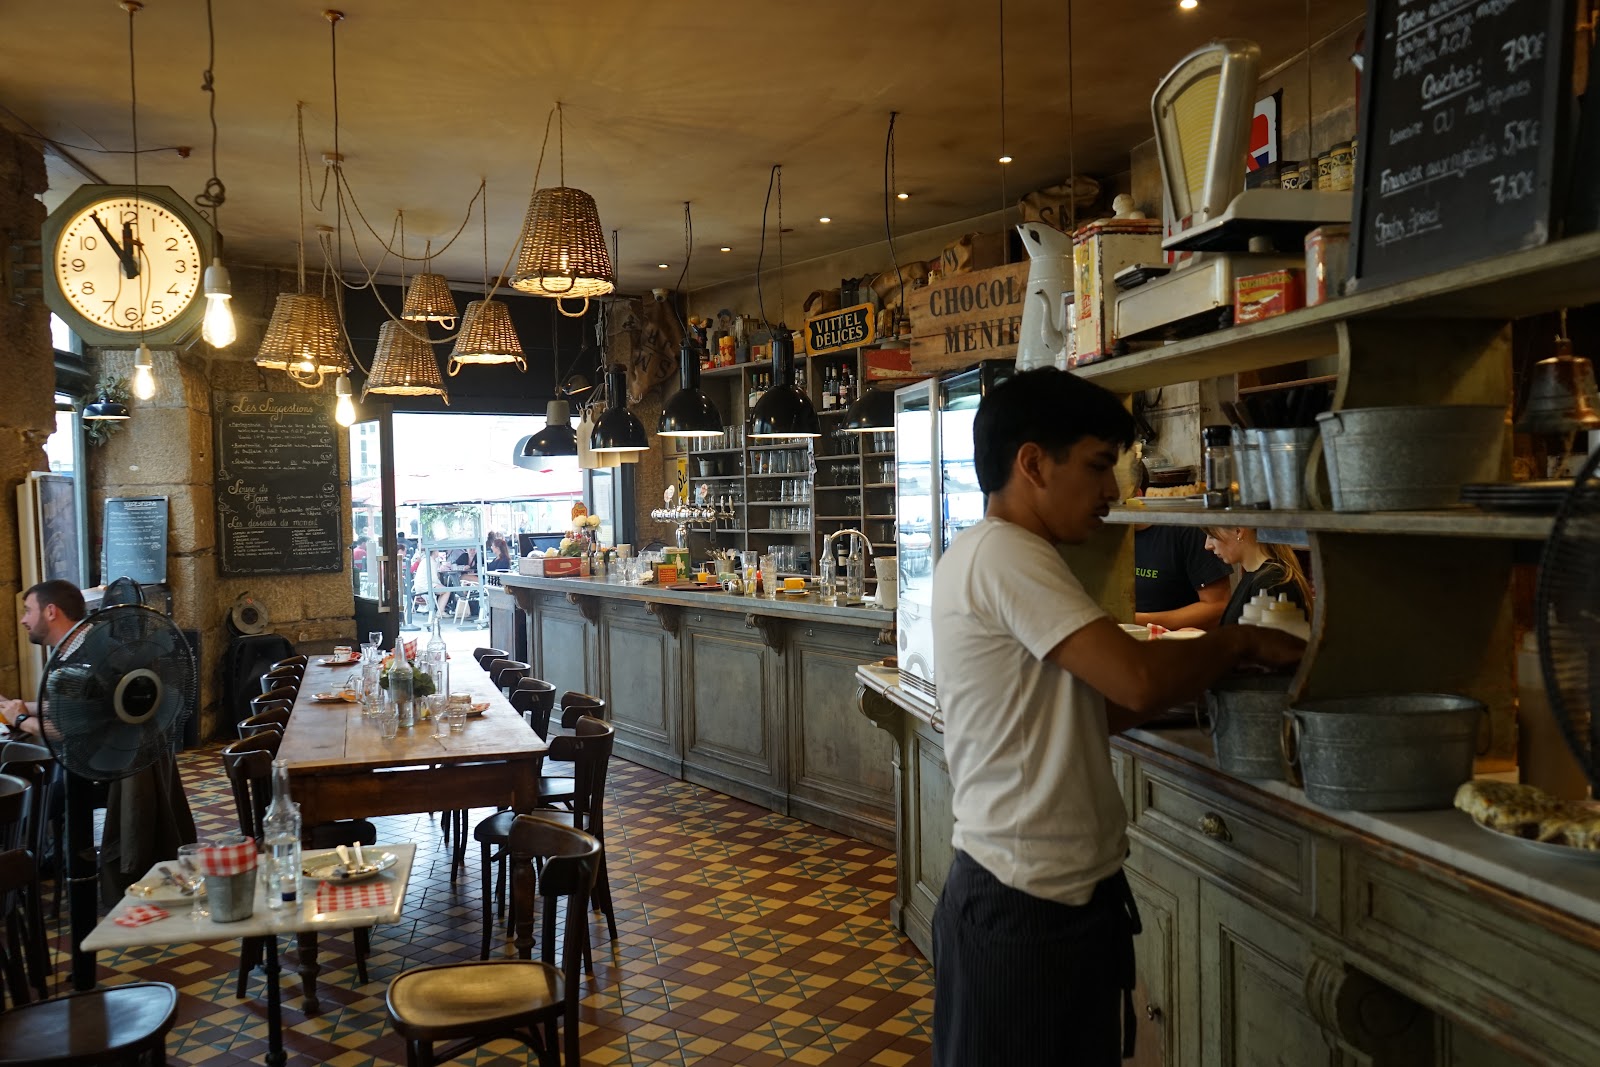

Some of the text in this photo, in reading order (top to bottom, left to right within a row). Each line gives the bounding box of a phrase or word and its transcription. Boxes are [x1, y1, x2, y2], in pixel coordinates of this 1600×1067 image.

[120, 211, 138, 225] 12
[80, 236, 97, 251] 10
[165, 237, 179, 252] 2
[72, 258, 85, 272] 9
[175, 259, 187, 274] 3
[81, 281, 95, 295] 8
[166, 282, 180, 297] 4
[929, 275, 1022, 318] CHOCOL
[102, 300, 116, 315] 7
[125, 307, 139, 322] 6
[151, 301, 164, 315] 5
[816, 312, 862, 334] VITTEL
[944, 315, 1023, 355] MENIE
[232, 397, 257, 413] Les
[260, 397, 314, 421] Suggestions
[227, 516, 243, 529] Les
[247, 518, 277, 527] desserts
[279, 518, 289, 527] du
[1135, 567, 1159, 579] EUSE
